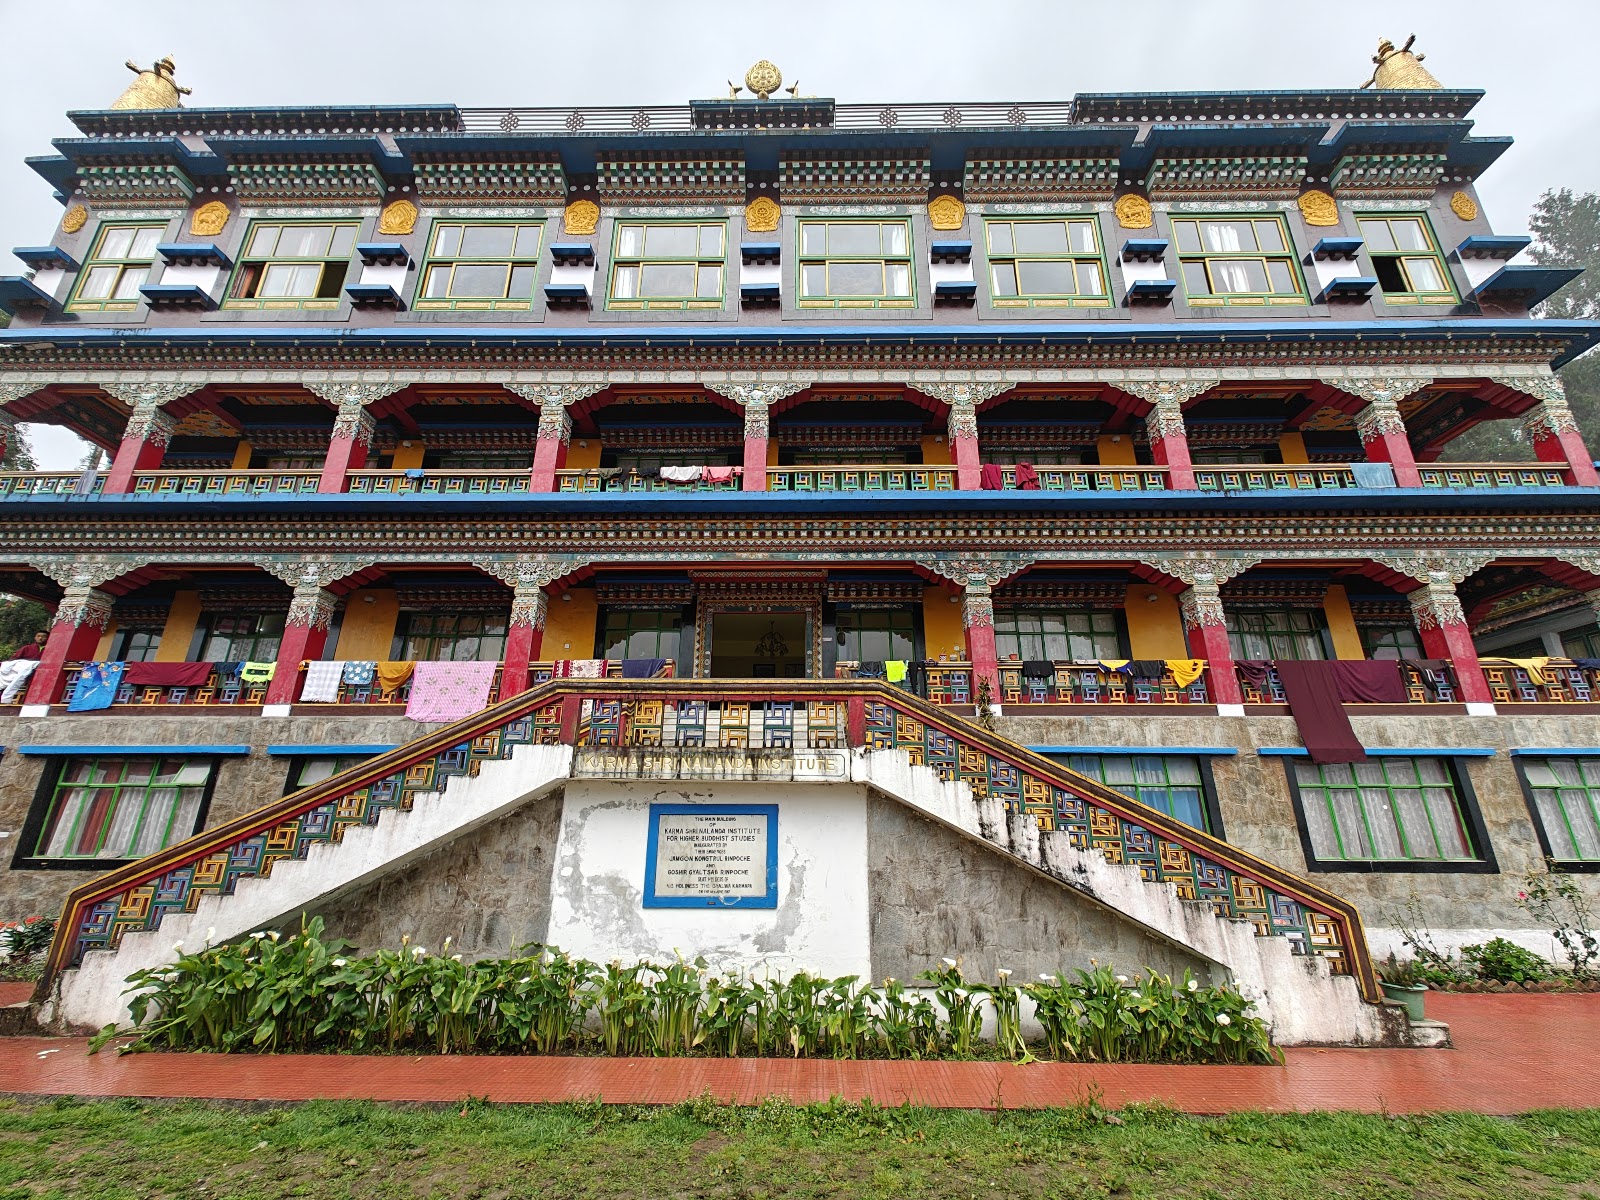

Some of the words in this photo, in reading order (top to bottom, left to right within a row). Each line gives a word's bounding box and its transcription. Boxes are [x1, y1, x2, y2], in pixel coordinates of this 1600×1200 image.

[585, 756, 638, 769] KARMA
[644, 757, 677, 770] SHRI
[681, 757, 754, 771] NALANDA
[758, 758, 835, 772] INSTITUTE
